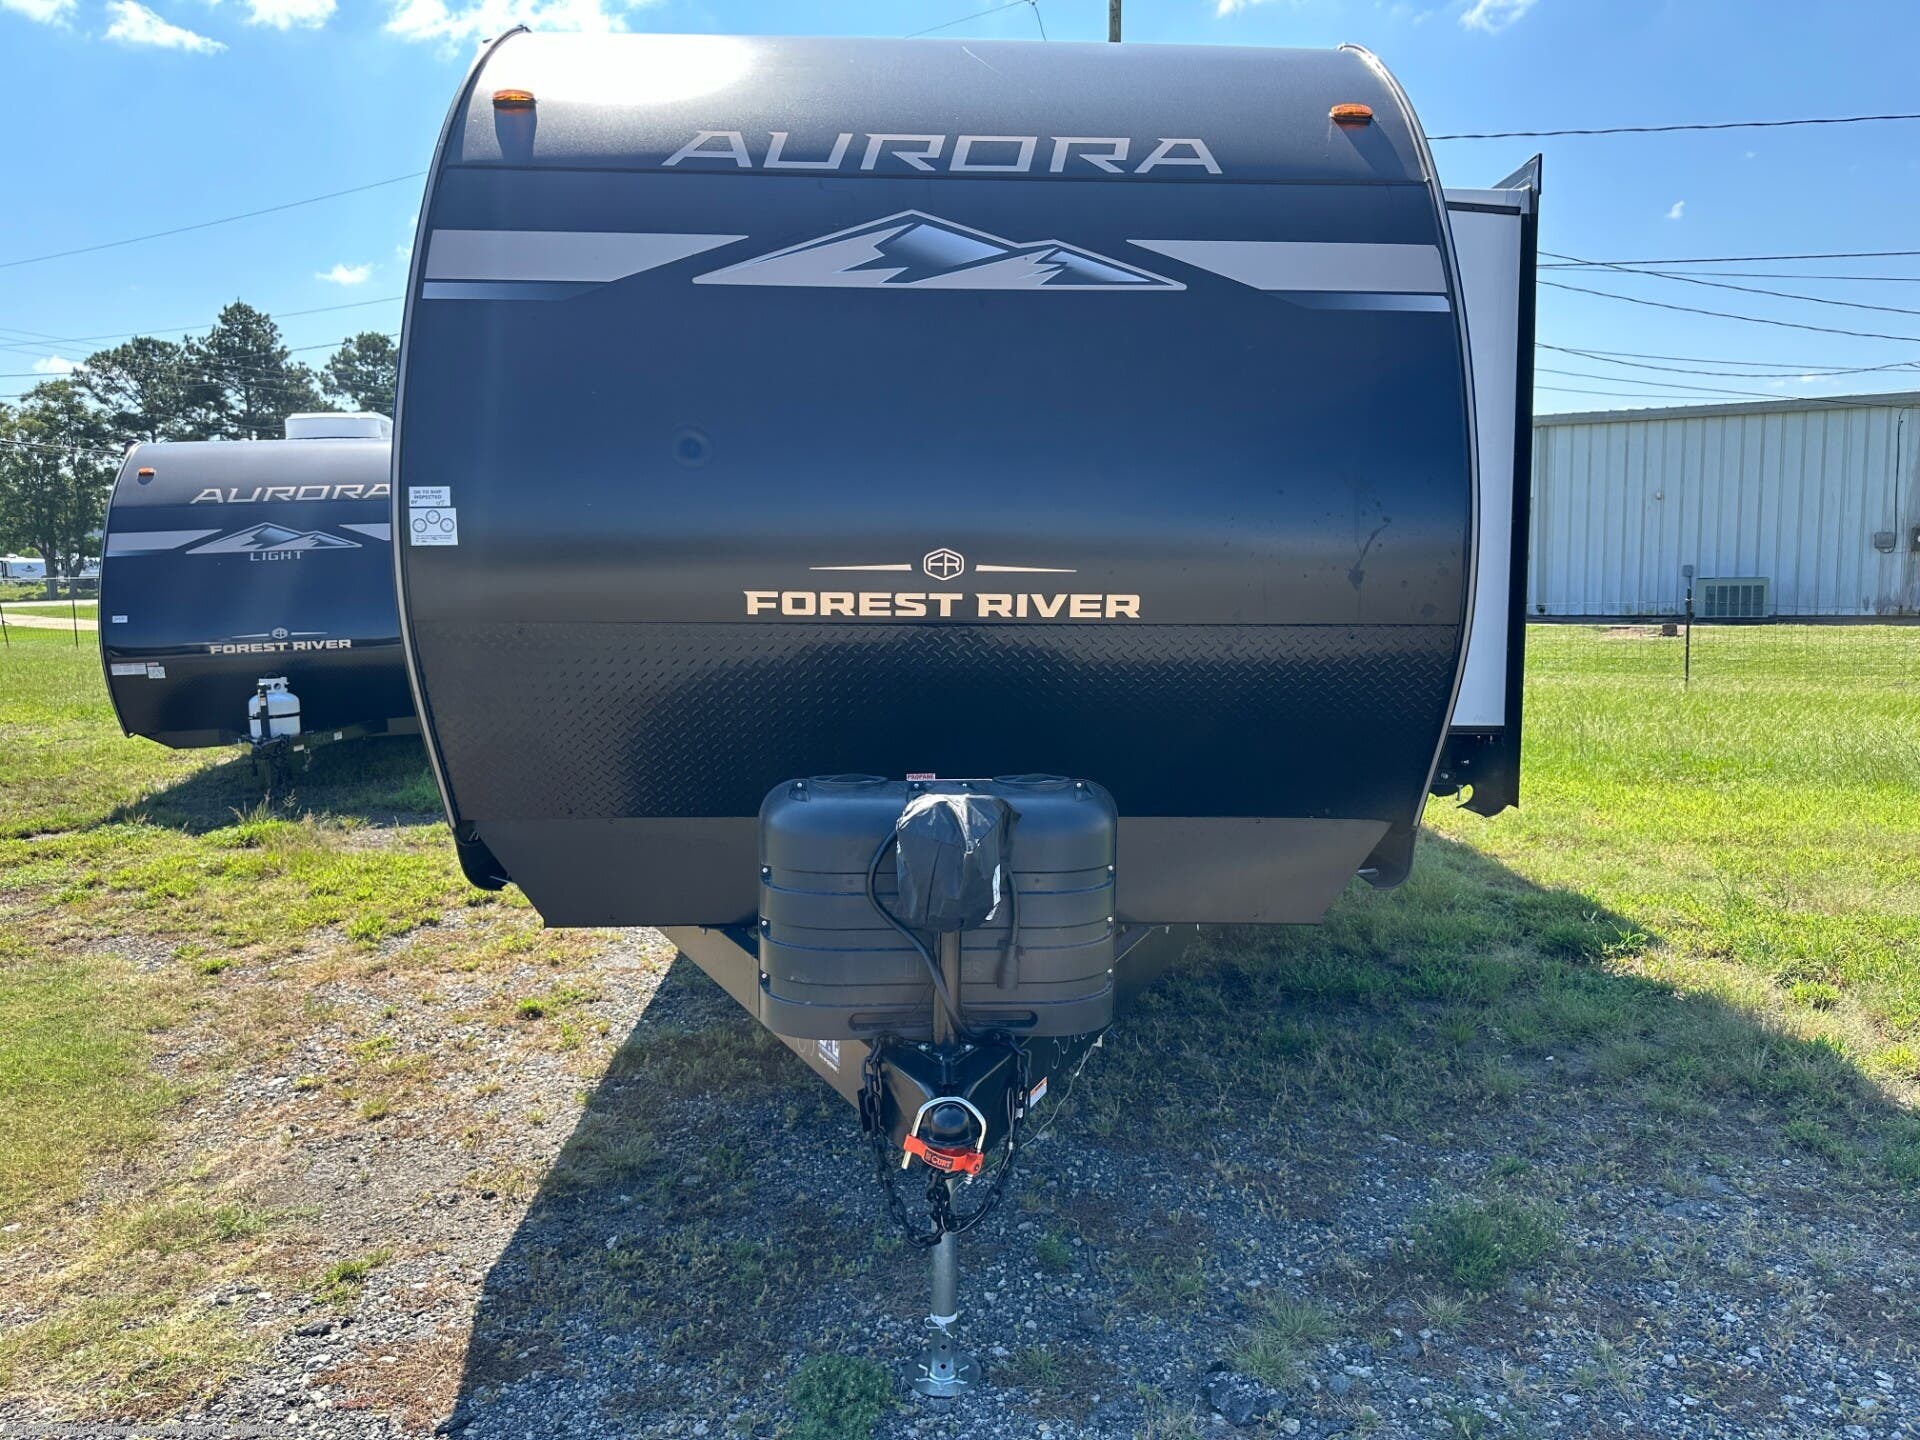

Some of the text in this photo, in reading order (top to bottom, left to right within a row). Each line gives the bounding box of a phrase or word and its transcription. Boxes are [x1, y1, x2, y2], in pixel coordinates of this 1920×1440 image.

[661, 130, 1223, 175] AURORA
[189, 483, 391, 505] AURORA
[250, 550, 304, 562] LIGHT
[743, 590, 1141, 619] FOREST RIVER
[209, 639, 352, 655] FOREST RIVER
